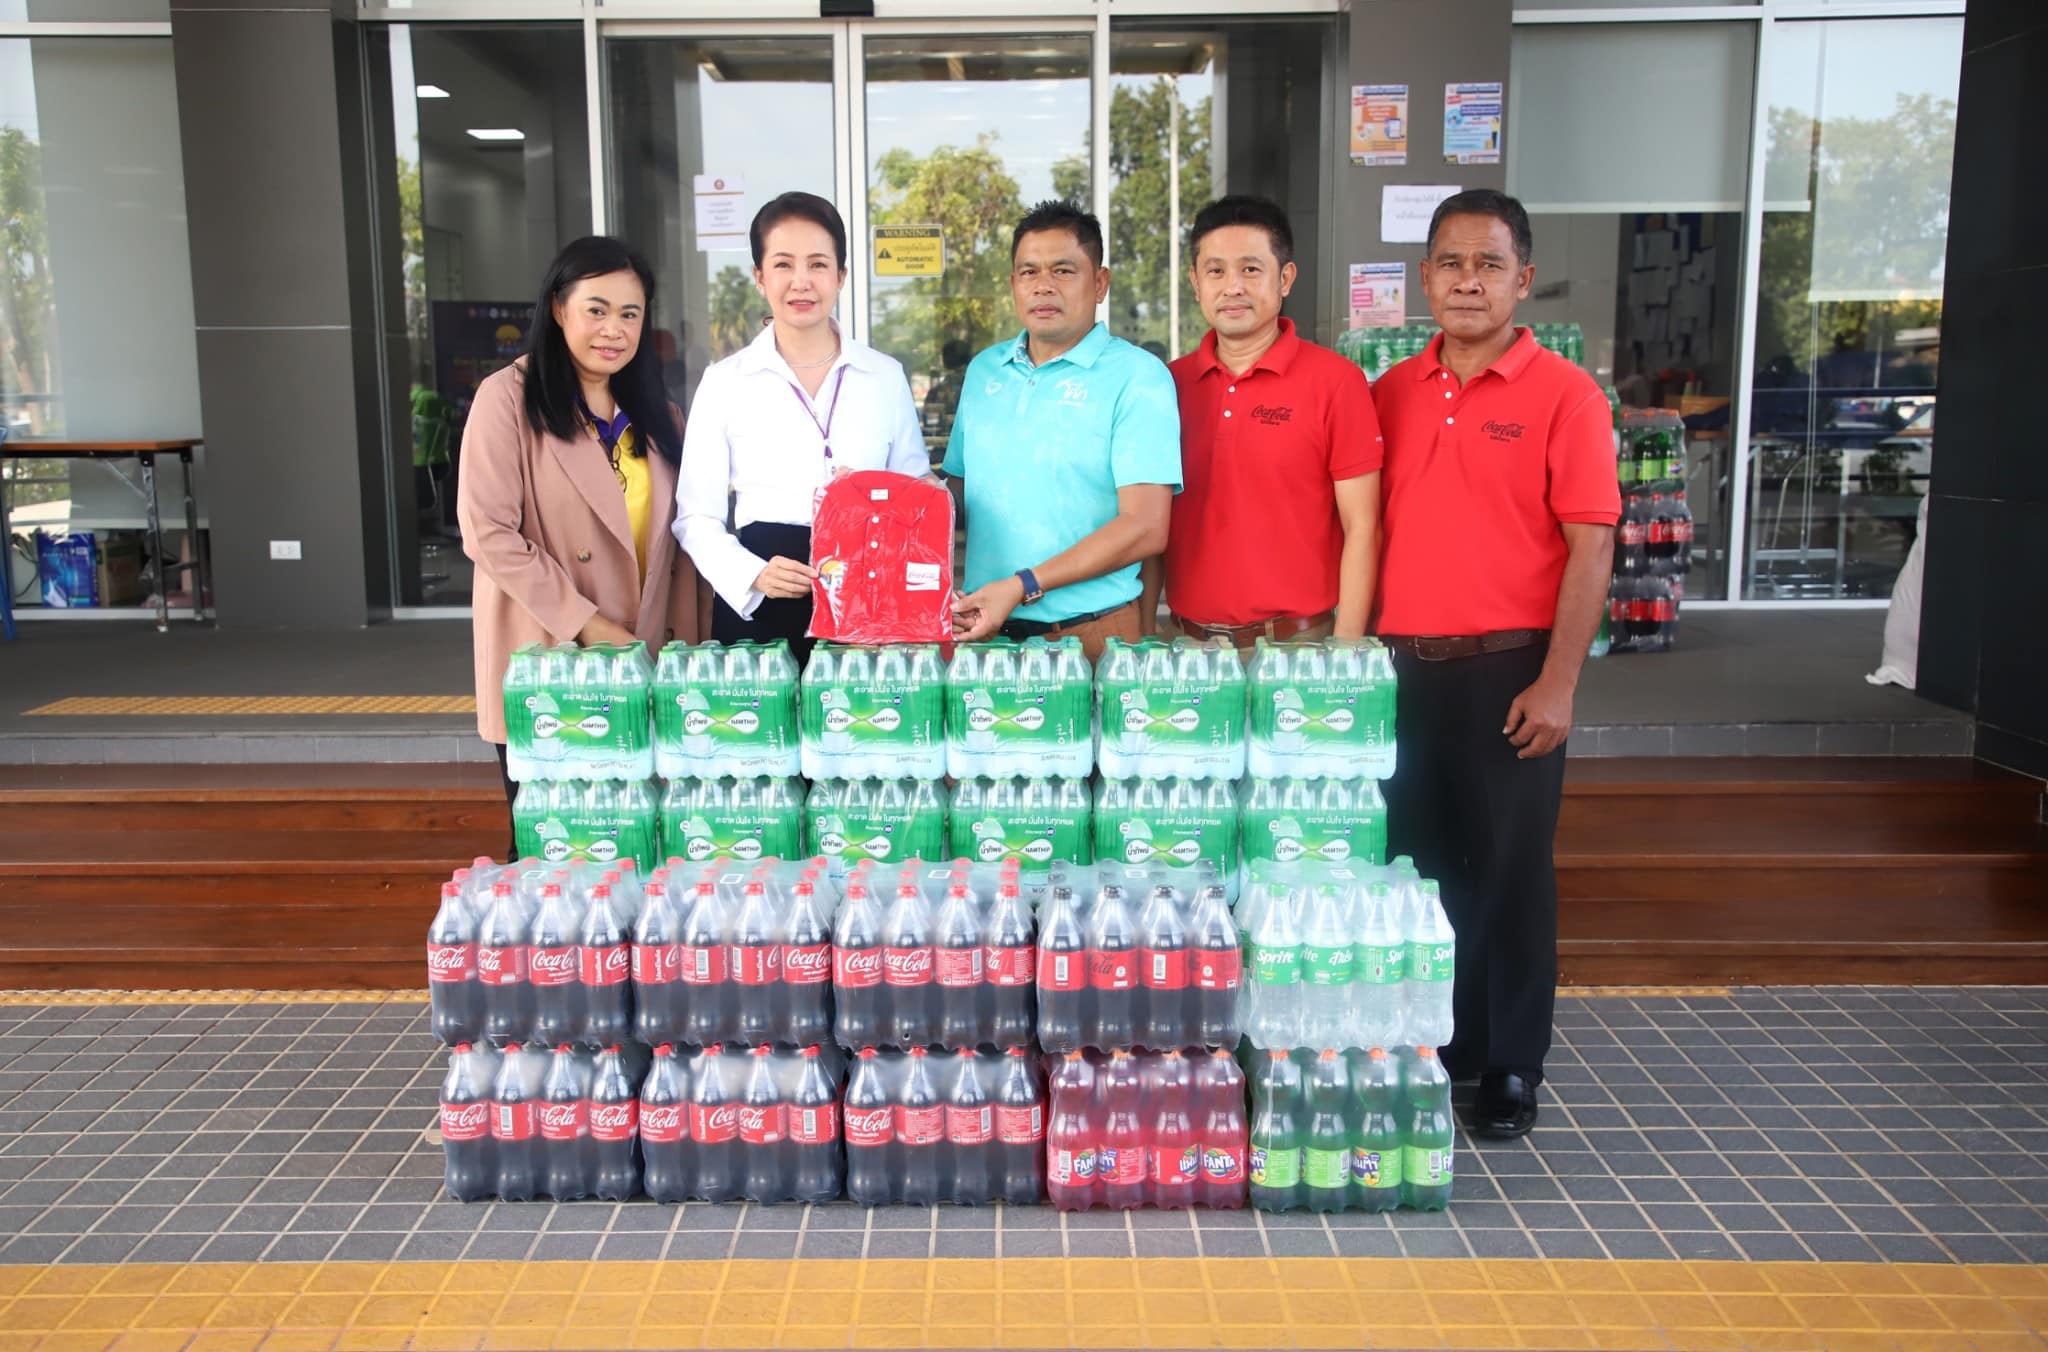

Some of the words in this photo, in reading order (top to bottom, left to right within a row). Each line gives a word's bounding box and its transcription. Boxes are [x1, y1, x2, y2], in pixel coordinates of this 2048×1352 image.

[884, 228, 930, 237] WARNING
[730, 718, 757, 726] NAMTHIP
[872, 716, 899, 724] NAMTHIP
[1016, 715, 1043, 724] NAMTHIP
[1171, 716, 1198, 724] NAMTHIP
[1326, 716, 1353, 724] NAMTHIP
[581, 722, 608, 730] NAMTHIP
[590, 846, 616, 854] NAMTHIP
[864, 843, 889, 851] NAMTHIP
[1025, 846, 1051, 854] NAMTHIP
[1172, 846, 1198, 855] NAMTHIP
[1322, 846, 1348, 854] NAMTHIP
[1256, 950, 1295, 965] Sprite
[1203, 1154, 1236, 1168] FANTA
